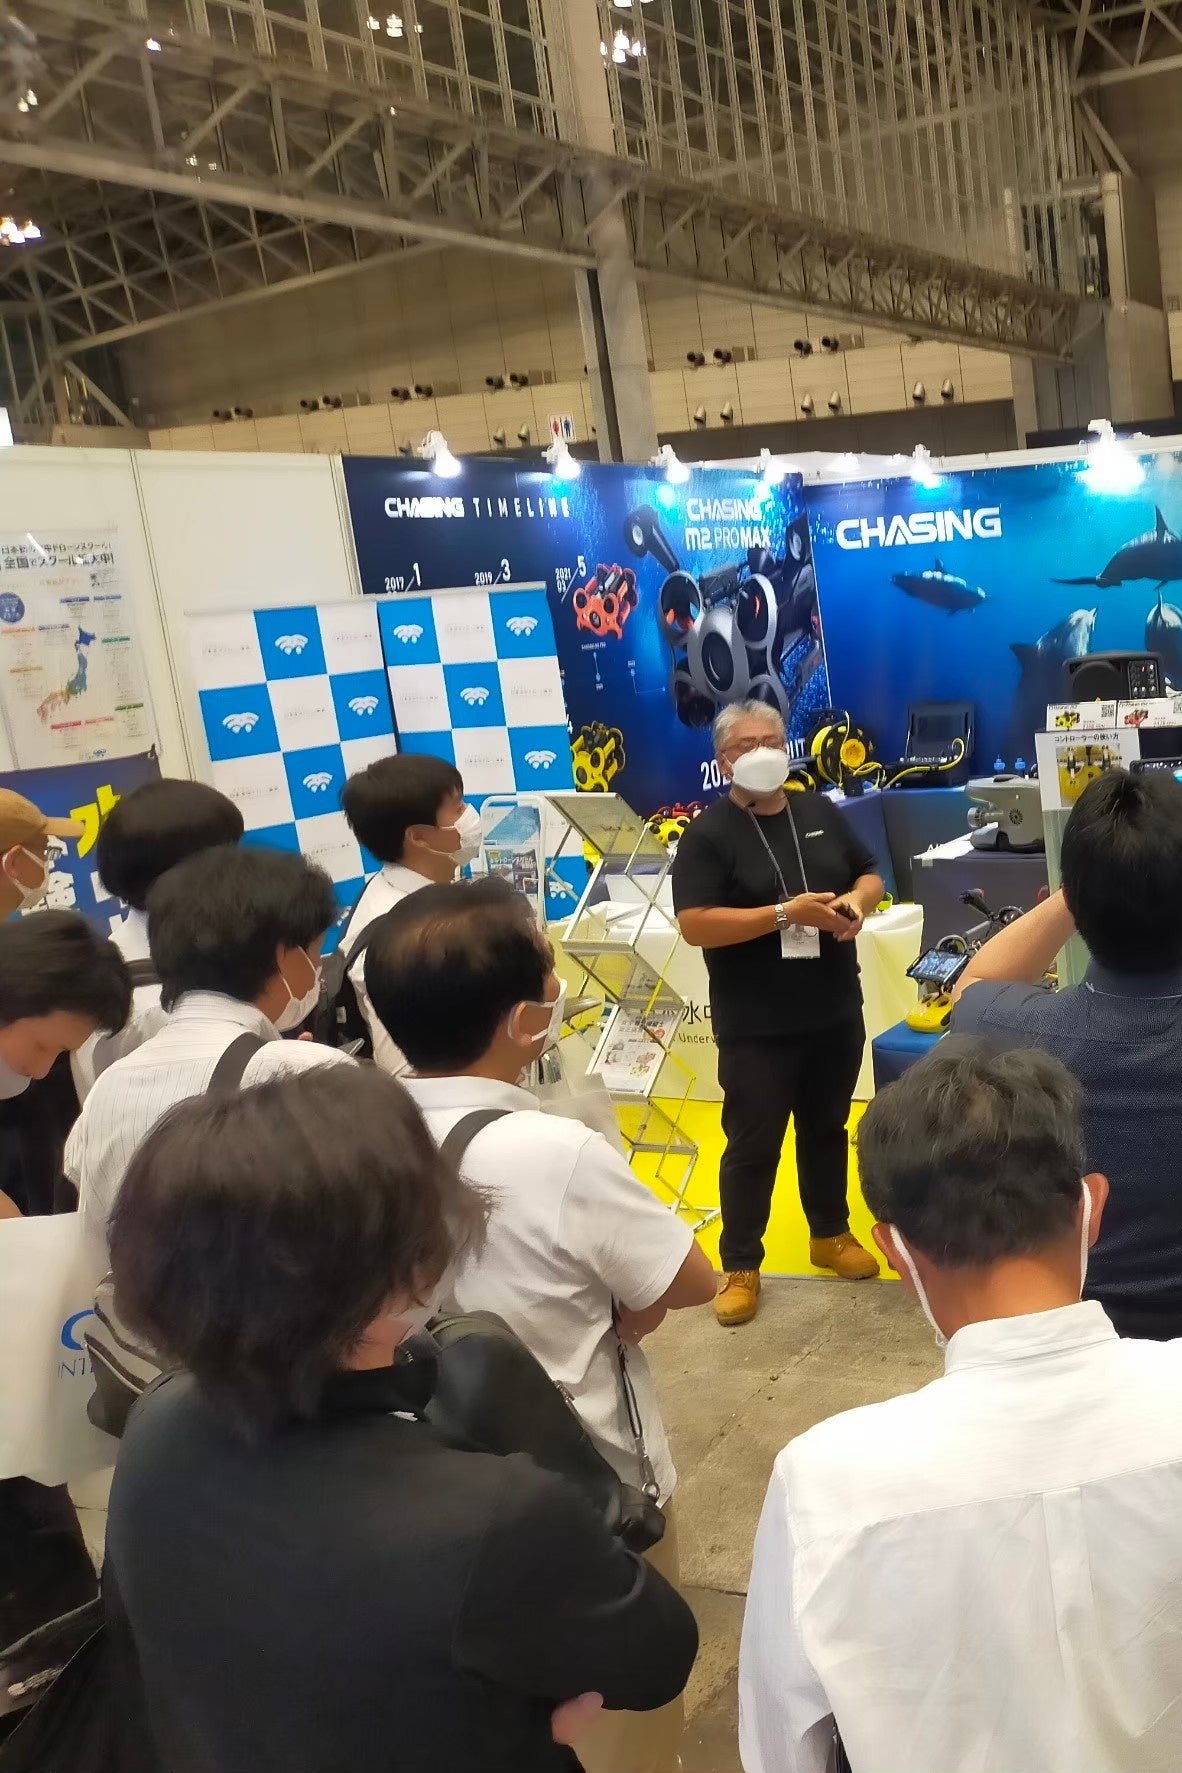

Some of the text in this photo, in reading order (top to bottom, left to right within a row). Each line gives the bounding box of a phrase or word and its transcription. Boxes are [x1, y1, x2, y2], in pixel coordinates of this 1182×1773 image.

[384, 496, 571, 519] CHASING TIMELINE
[686, 497, 763, 521] CHASING
[835, 506, 1003, 551] CHASING
[384, 562, 422, 591] 2017 1
[500, 558, 511, 582] 3
[577, 555, 587, 578] 5
